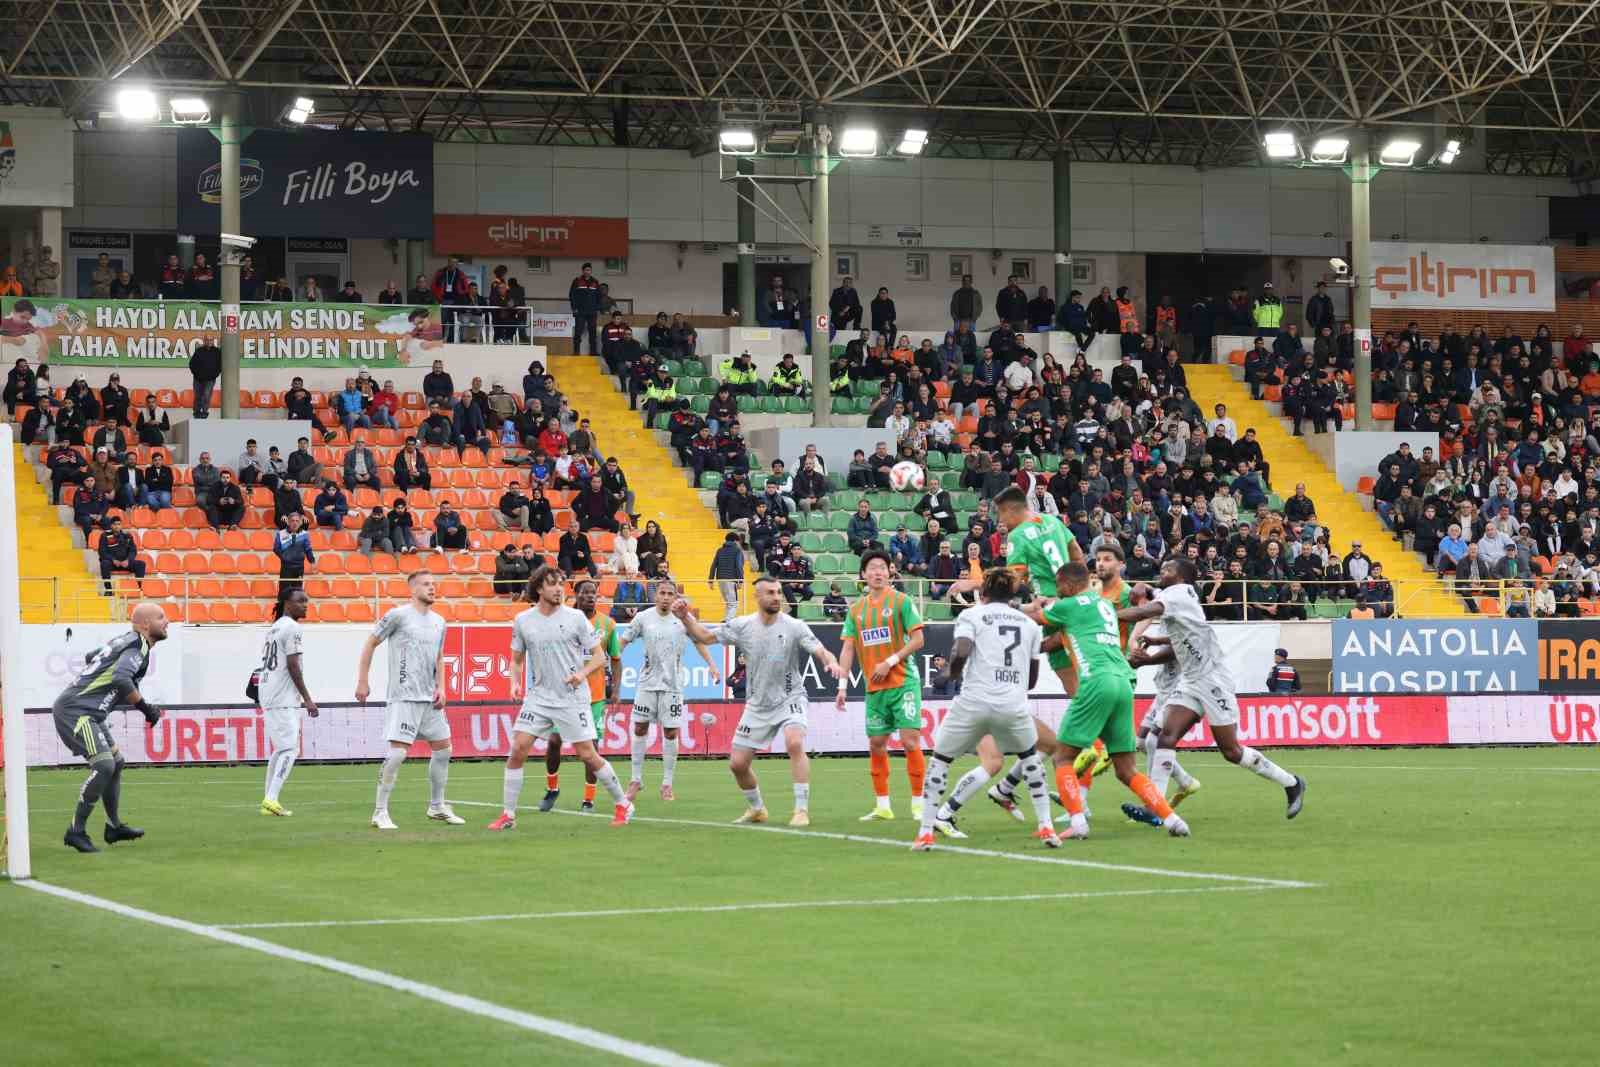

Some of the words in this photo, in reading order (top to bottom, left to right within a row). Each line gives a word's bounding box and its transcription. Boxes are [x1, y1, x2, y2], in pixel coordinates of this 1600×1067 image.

[283, 163, 337, 205] Filli
[344, 161, 419, 203] Boya
[96, 304, 166, 329] HAYDİ
[173, 309, 282, 330] ALAYAM
[290, 308, 365, 331] SENDE
[227, 315, 237, 328] B
[818, 315, 827, 328] C
[59, 335, 120, 357] TAHA
[243, 333, 340, 359] ELİNDEN
[348, 338, 387, 360] TUT
[1097, 600, 1118, 634] 9
[998, 625, 1021, 667] 7
[1341, 628, 1527, 656] ANATOLIA
[578, 711, 588, 728] 5
[903, 701, 916, 720] 16
[144, 707, 304, 762] ÜRETİ
